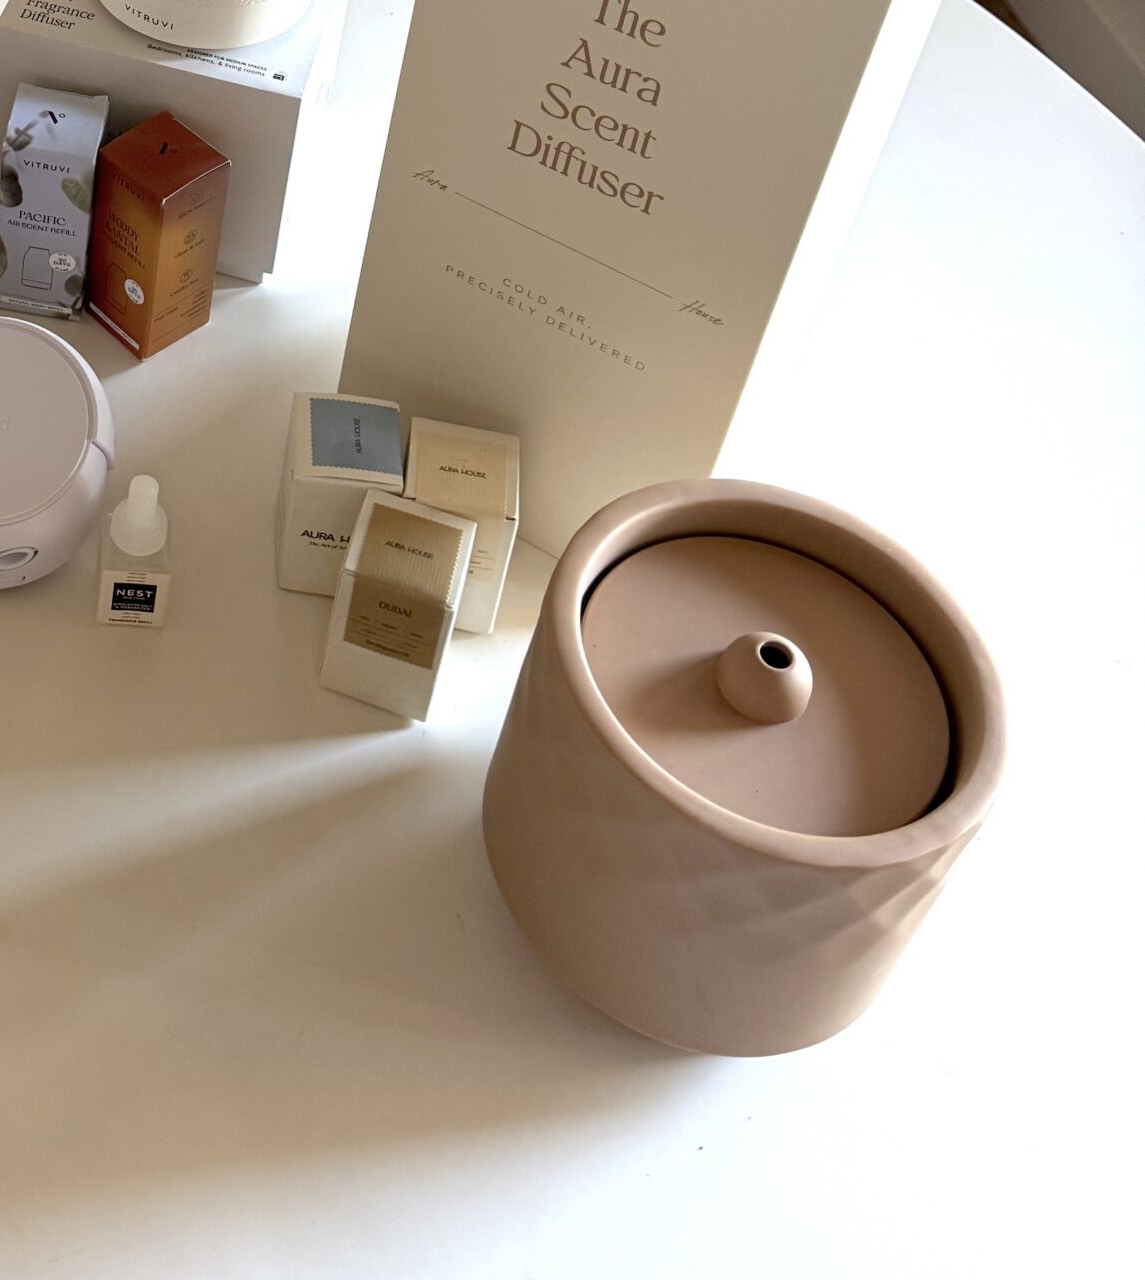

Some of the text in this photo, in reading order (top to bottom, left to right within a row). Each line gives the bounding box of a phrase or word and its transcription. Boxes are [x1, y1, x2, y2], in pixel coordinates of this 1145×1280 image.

[19, 8, 76, 30] Diffuser
[124, 3, 174, 30] VITRUVI
[225, 63, 242, 72] living
[243, 68, 265, 77] rooms
[560, 37, 661, 106] Aura
[540, 82, 657, 159] Scent
[23, 159, 70, 174] VITRUVI
[506, 119, 665, 215] Diffuser
[19, 210, 67, 226] PACIFIC
[8, 219, 78, 237] AIR SCENT REFILL
[412, 170, 725, 326] Aura House
[502, 277, 548, 306] COLD
[445, 264, 646, 372] PRECISELY DELIVERED
[439, 465, 486, 480] AURA HOUSE
[301, 529, 335, 542] AURA
[384, 540, 434, 559] AURA HOUSE
[116, 589, 153, 598] NEST
[378, 600, 413, 618] DUBAI
